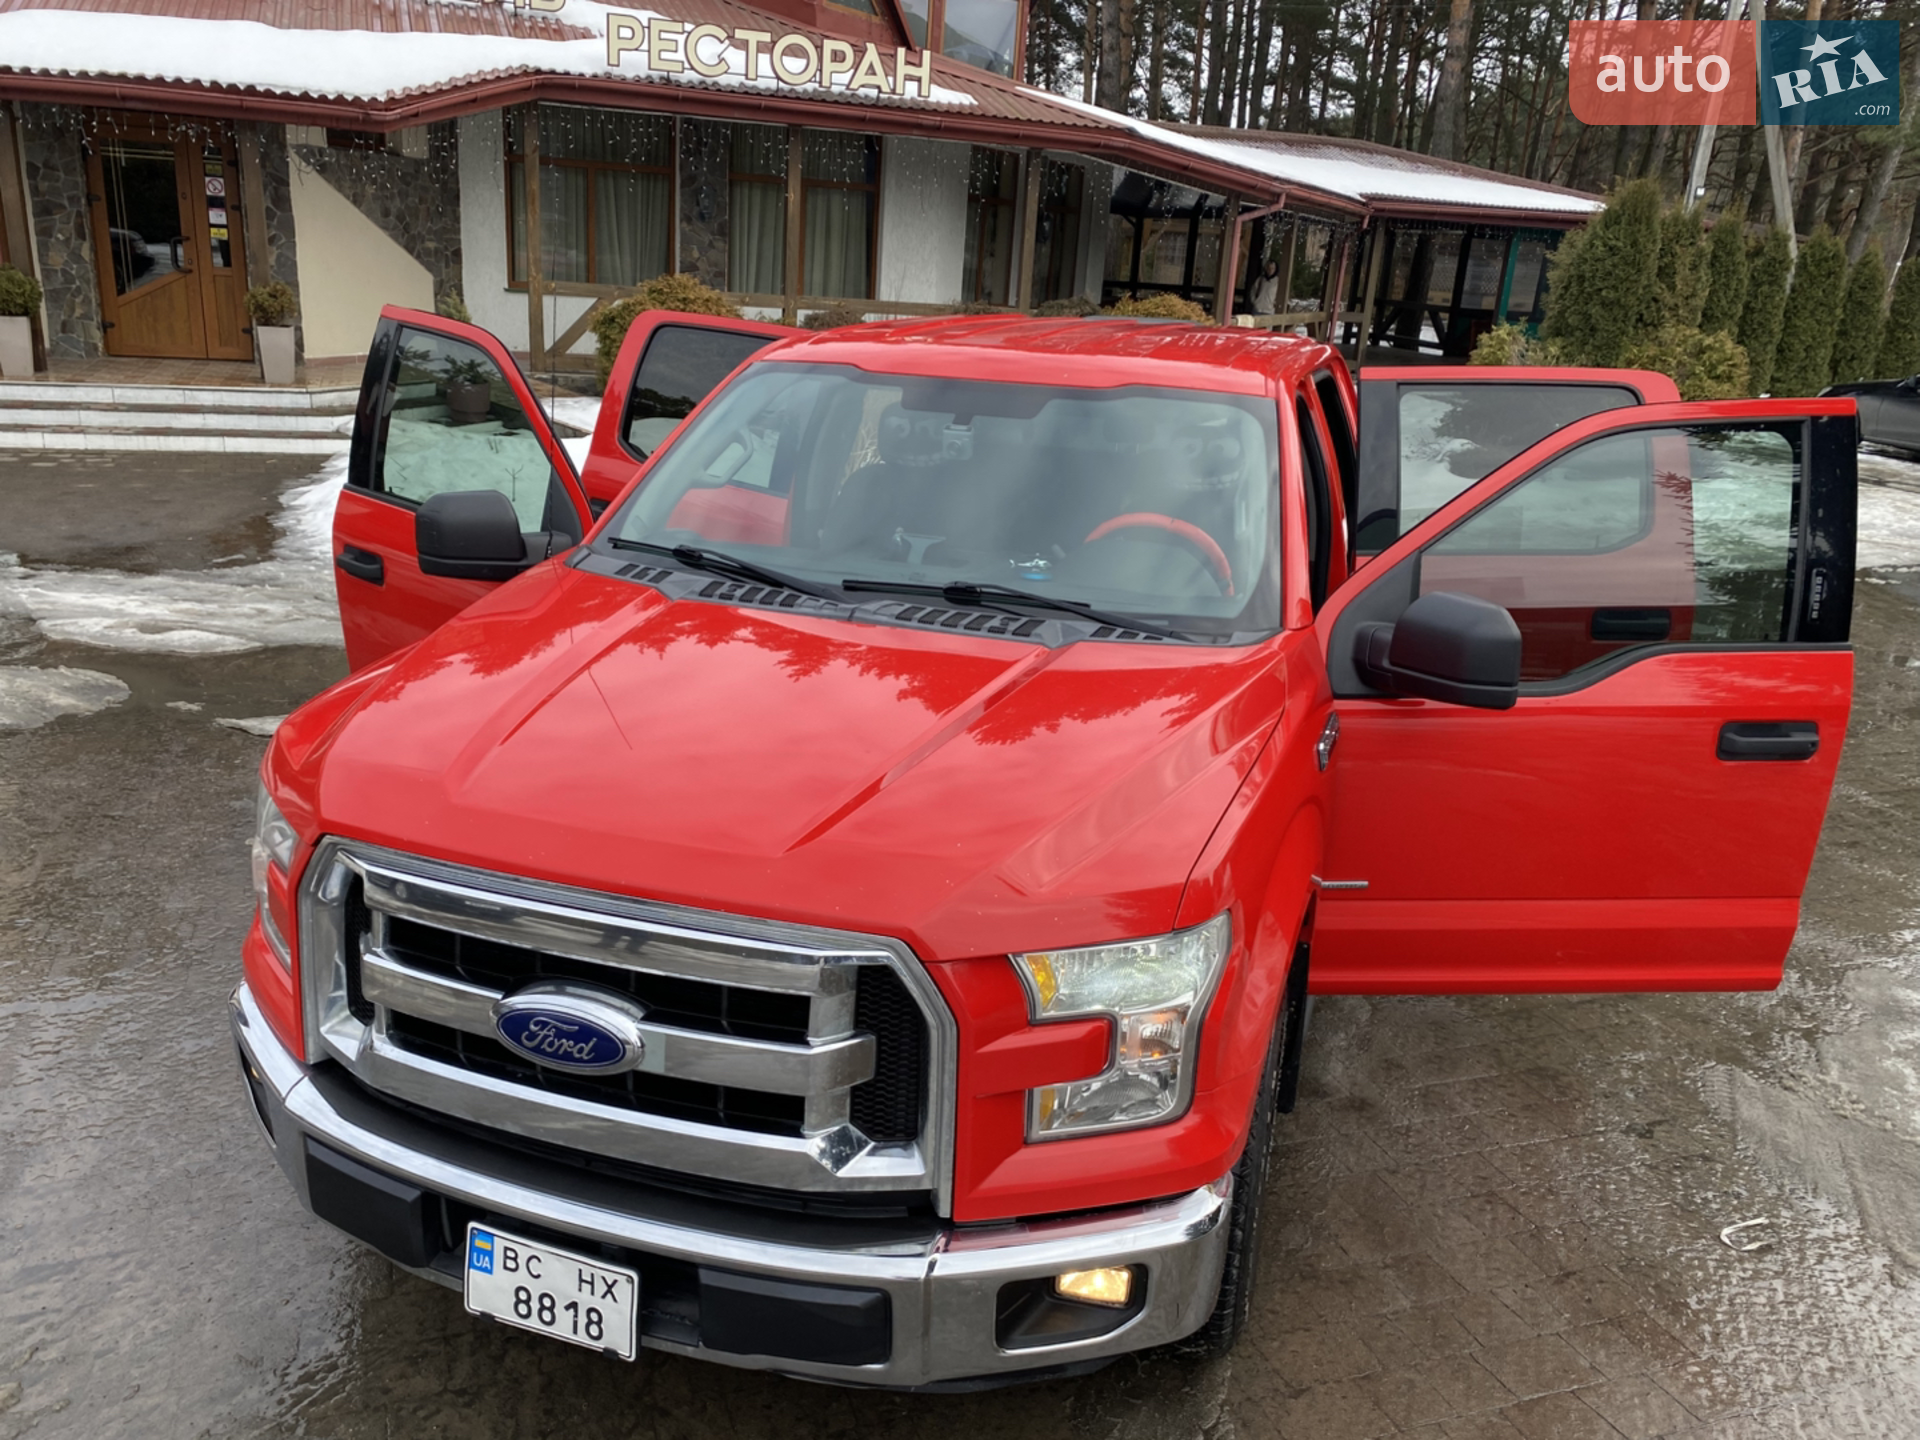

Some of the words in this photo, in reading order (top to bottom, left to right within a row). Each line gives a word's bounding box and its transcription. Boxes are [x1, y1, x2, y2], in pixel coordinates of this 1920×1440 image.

[606, 12, 932, 98] РЕСТОРАН
[521, 1016, 598, 1060] Ford
[472, 1252, 492, 1270] UA
[502, 1245, 542, 1280] BC
[578, 1267, 619, 1304] HX
[513, 1285, 604, 1341] 8818
